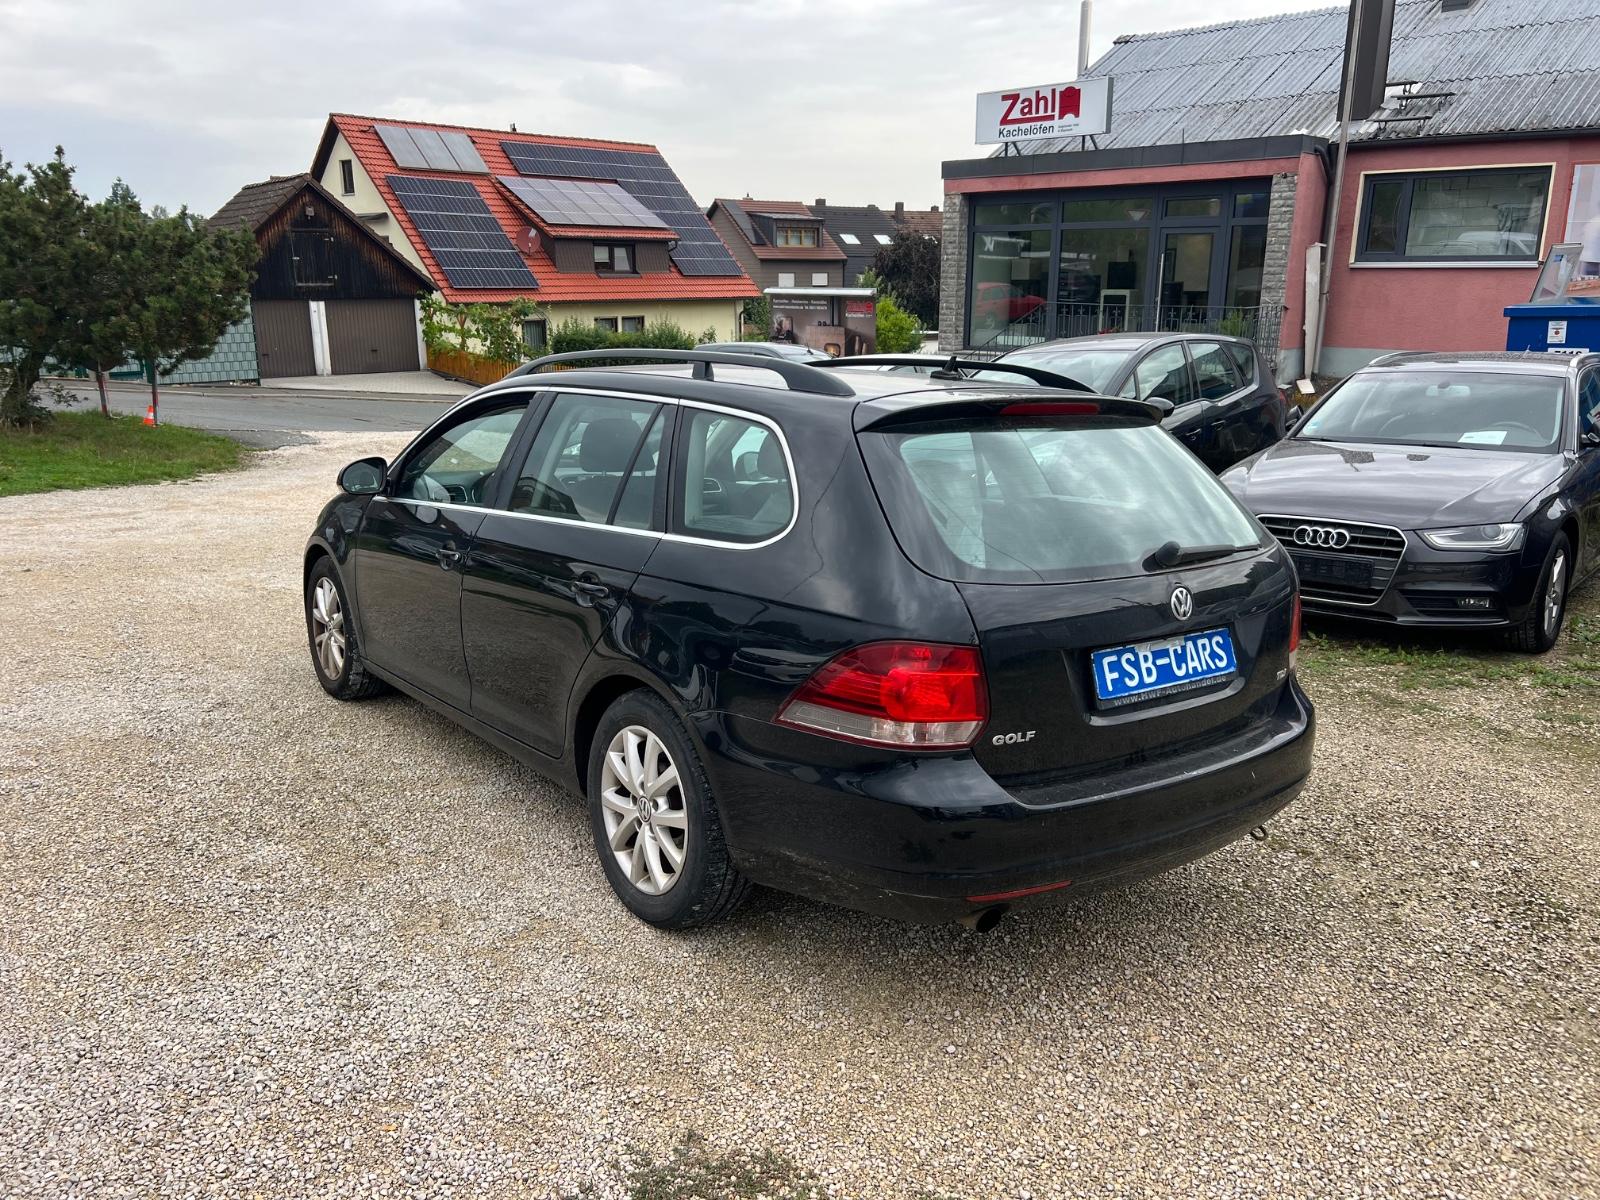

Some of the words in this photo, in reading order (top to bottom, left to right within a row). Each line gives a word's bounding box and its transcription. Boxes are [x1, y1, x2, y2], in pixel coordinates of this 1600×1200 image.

[1000, 88, 1056, 126] Zahl
[998, 124, 1054, 138] Kachelöfen
[1102, 635, 1228, 691] FSB-CARS
[992, 730, 1036, 746] GOLF
